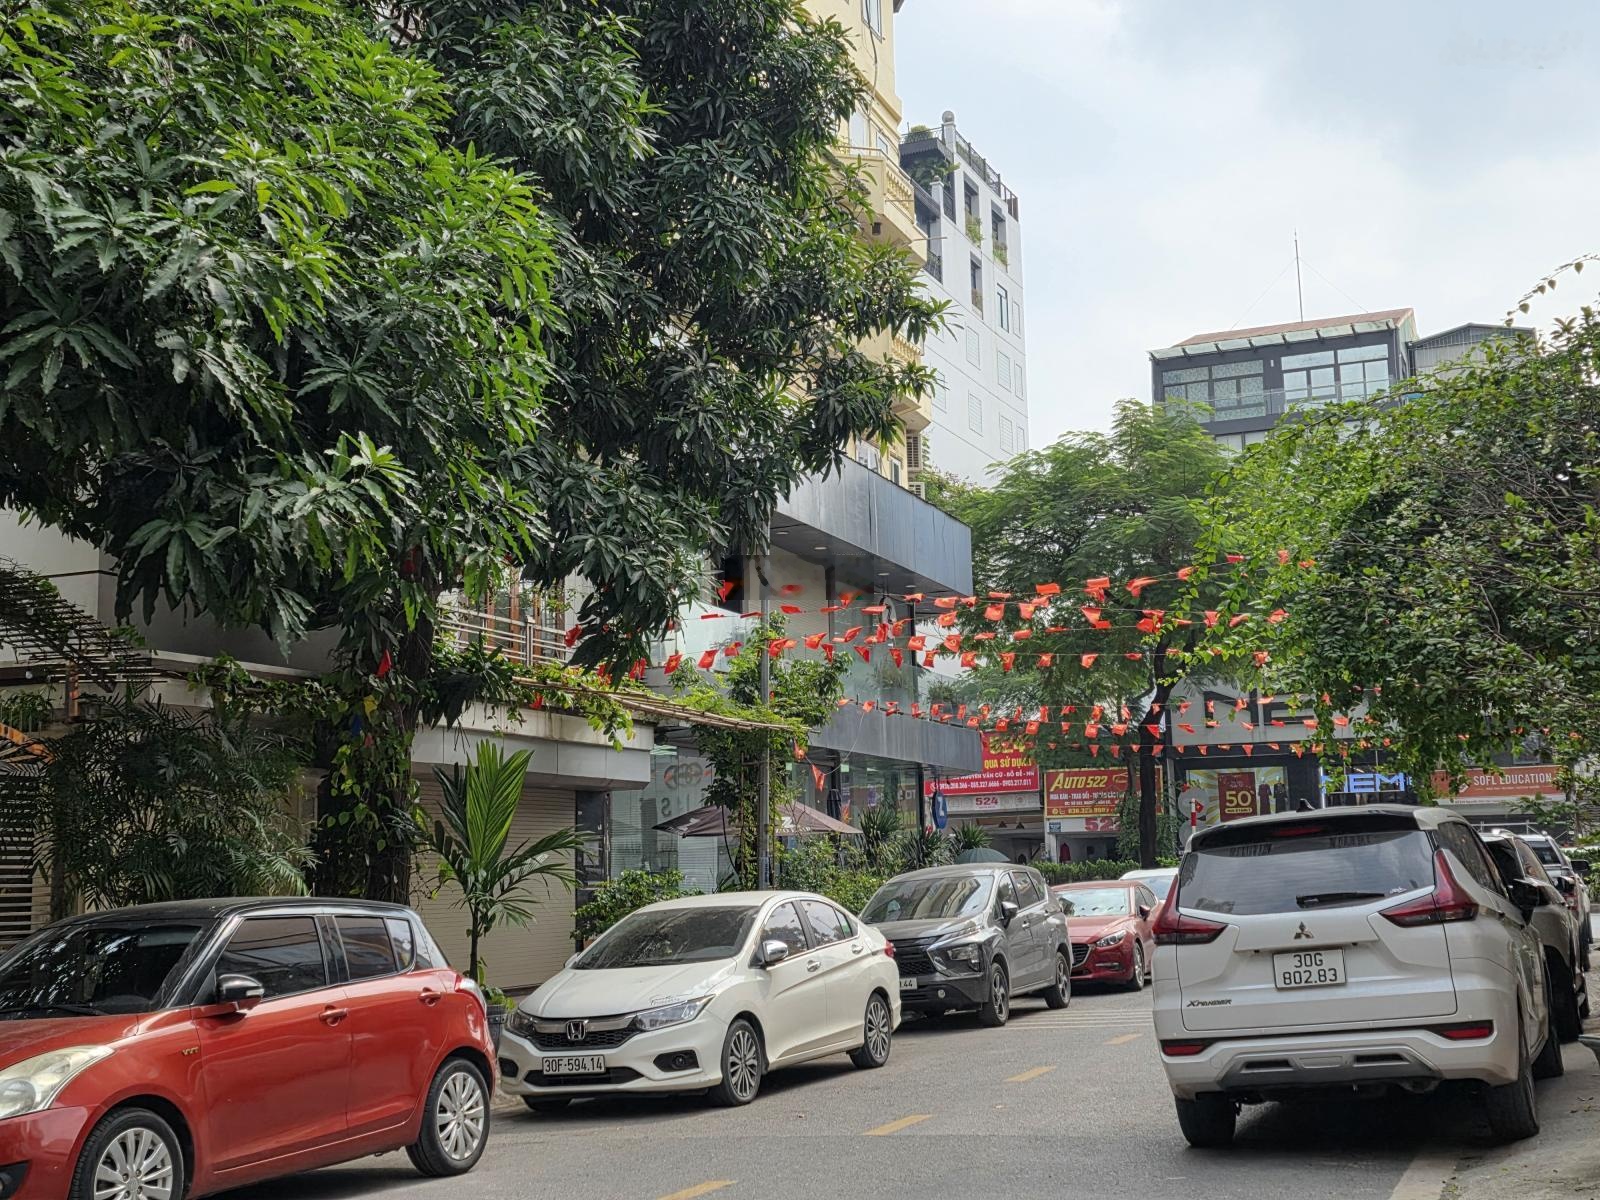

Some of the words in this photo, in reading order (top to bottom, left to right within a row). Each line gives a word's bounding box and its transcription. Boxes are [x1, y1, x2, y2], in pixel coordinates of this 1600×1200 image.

[1203, 688, 1335, 727] NE
[984, 759, 999, 769] QUA
[1000, 756, 1009, 769] SỬ
[1086, 776, 1108, 788] 522
[1473, 775, 1497, 786] SOFL
[1500, 772, 1552, 785] EDUCATION
[975, 796, 999, 806] 524
[1293, 952, 1324, 968] 30G
[1282, 968, 1338, 986] 802.83
[544, 1057, 603, 1073] 30F-594.14
